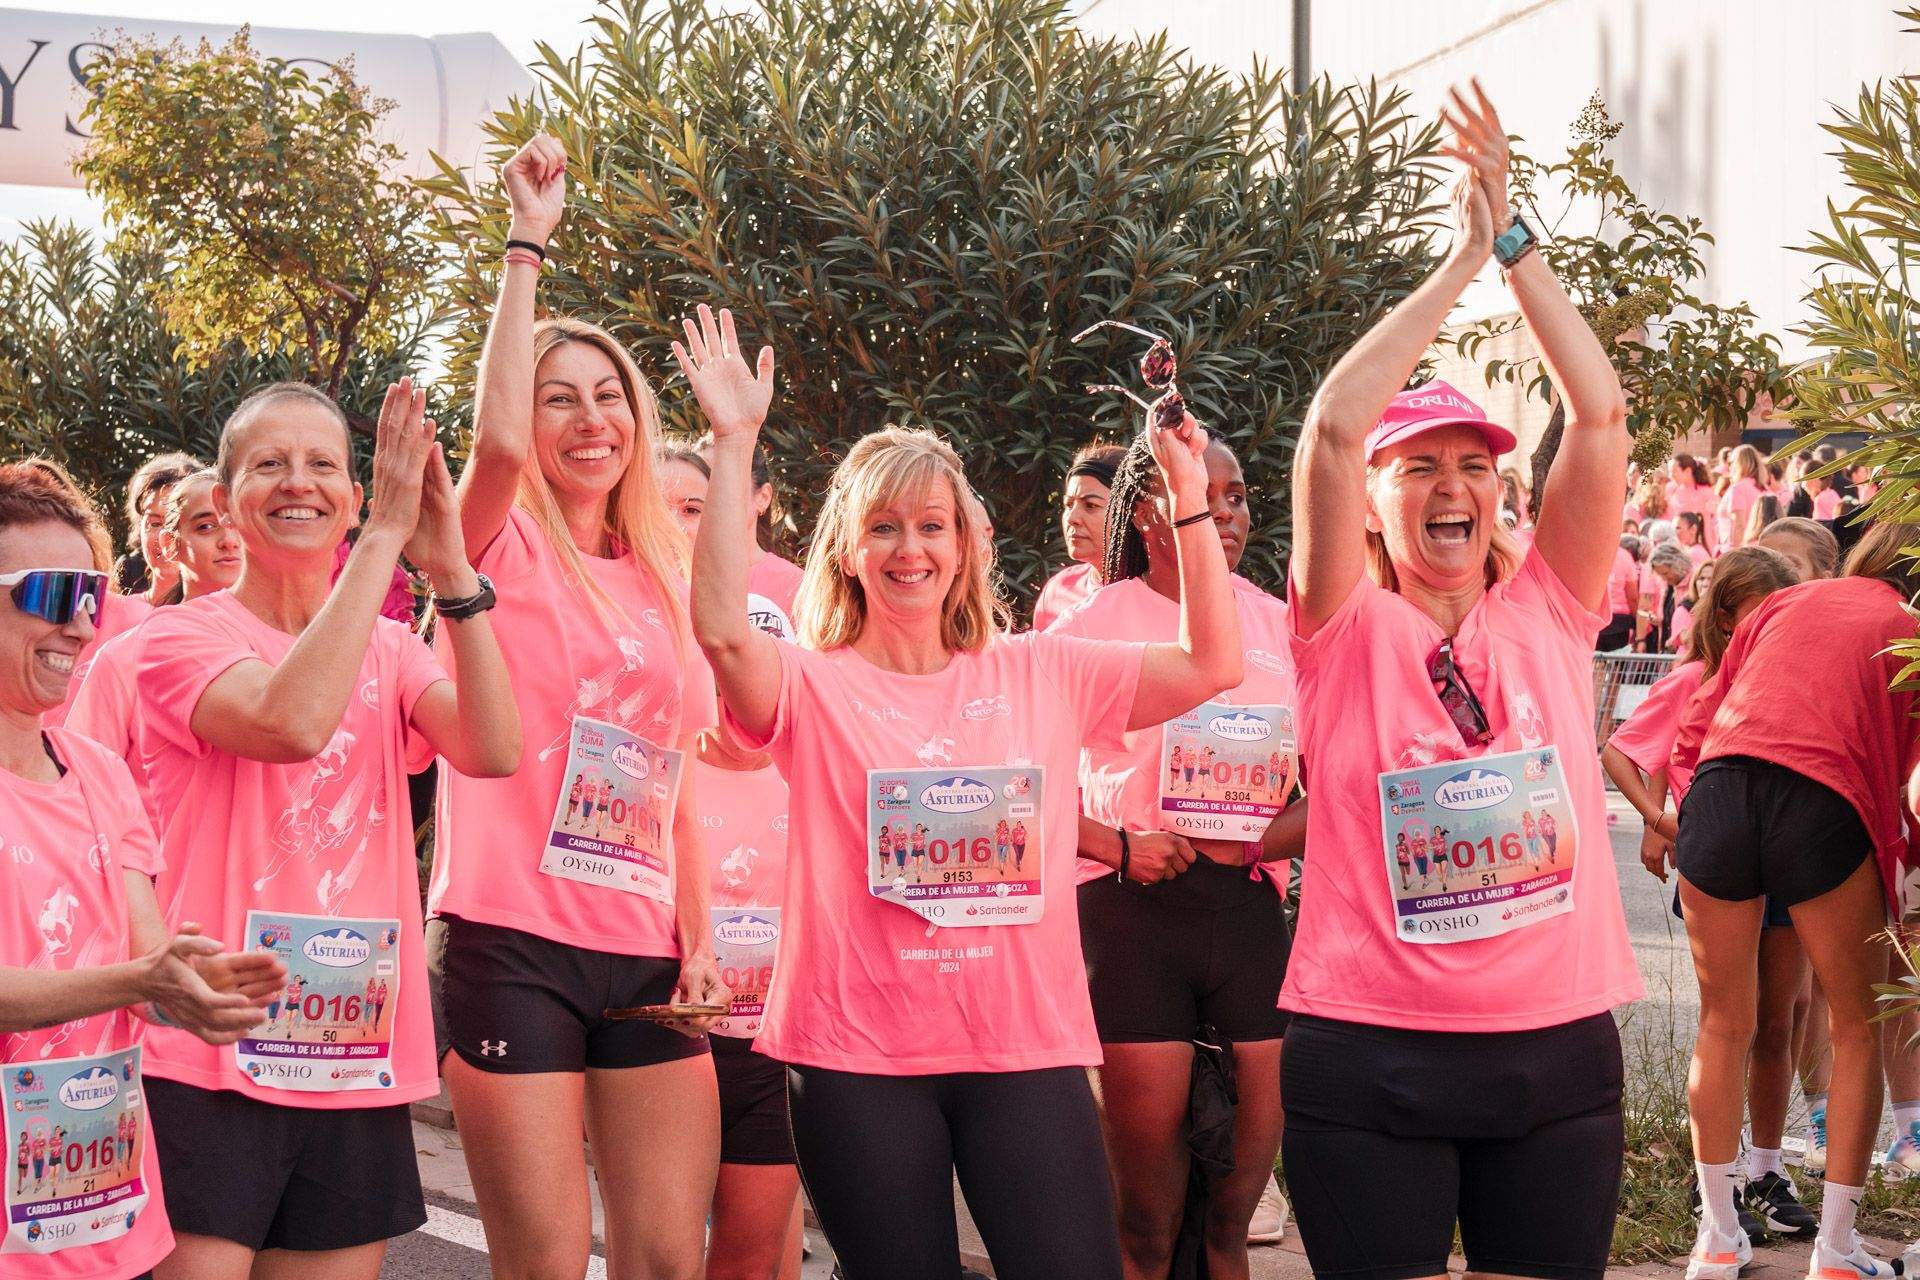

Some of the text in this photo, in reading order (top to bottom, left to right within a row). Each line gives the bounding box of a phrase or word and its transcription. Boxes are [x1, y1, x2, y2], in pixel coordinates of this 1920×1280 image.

[1213, 721, 1269, 736] ASTURIANA
[580, 734, 605, 748] SUMA
[615, 749, 648, 774] ASTURIANA
[1213, 761, 1266, 787] 016
[926, 791, 990, 806] ASTURIANA
[1224, 790, 1251, 802] 8304
[1441, 784, 1510, 804] ASTURIANA
[1176, 800, 1208, 810] CARRERA
[1210, 802, 1221, 811] DE
[1221, 803, 1231, 811] LA
[1232, 804, 1255, 813] MUJER
[1400, 800, 1425, 809] Zaragoza
[610, 798, 648, 831] 016
[1175, 816, 1224, 831] OYSHO
[624, 833, 636, 847] 52
[568, 837, 642, 861] CARRERA DE LA MUJER
[928, 837, 992, 865] 016
[1451, 832, 1524, 868] 016
[562, 855, 615, 877] OYSHO
[943, 870, 973, 883] 9153
[1481, 873, 1497, 887] 51
[928, 886, 940, 896] DE
[940, 886, 951, 895] LA
[952, 885, 979, 895] MUJER
[1416, 875, 1558, 910] CARRERA DE LA MUJER ZARAGOZA
[979, 904, 1029, 916] Santander
[1513, 896, 1559, 918] Santander
[1419, 913, 1479, 934] OYSHO
[718, 925, 774, 939] ASTURIANA
[308, 941, 367, 958] ASTURIANA
[900, 945, 994, 961] CARRERA DE LA MUJER
[938, 961, 960, 974] 2024
[721, 965, 774, 989] 016
[732, 994, 758, 1004] 4466
[303, 993, 361, 1022] 016
[739, 1005, 761, 1014] MUJER
[322, 1029, 337, 1042] 50
[255, 1042, 296, 1054] CARRERA
[297, 1044, 310, 1055] DE
[310, 1045, 321, 1055] LA
[340, 1068, 376, 1080] Santander
[66, 1135, 114, 1174] 016
[82, 1178, 96, 1193] 21
[26, 1202, 62, 1217] CARRERA
[63, 1200, 74, 1212] DE
[73, 1198, 83, 1209] LA
